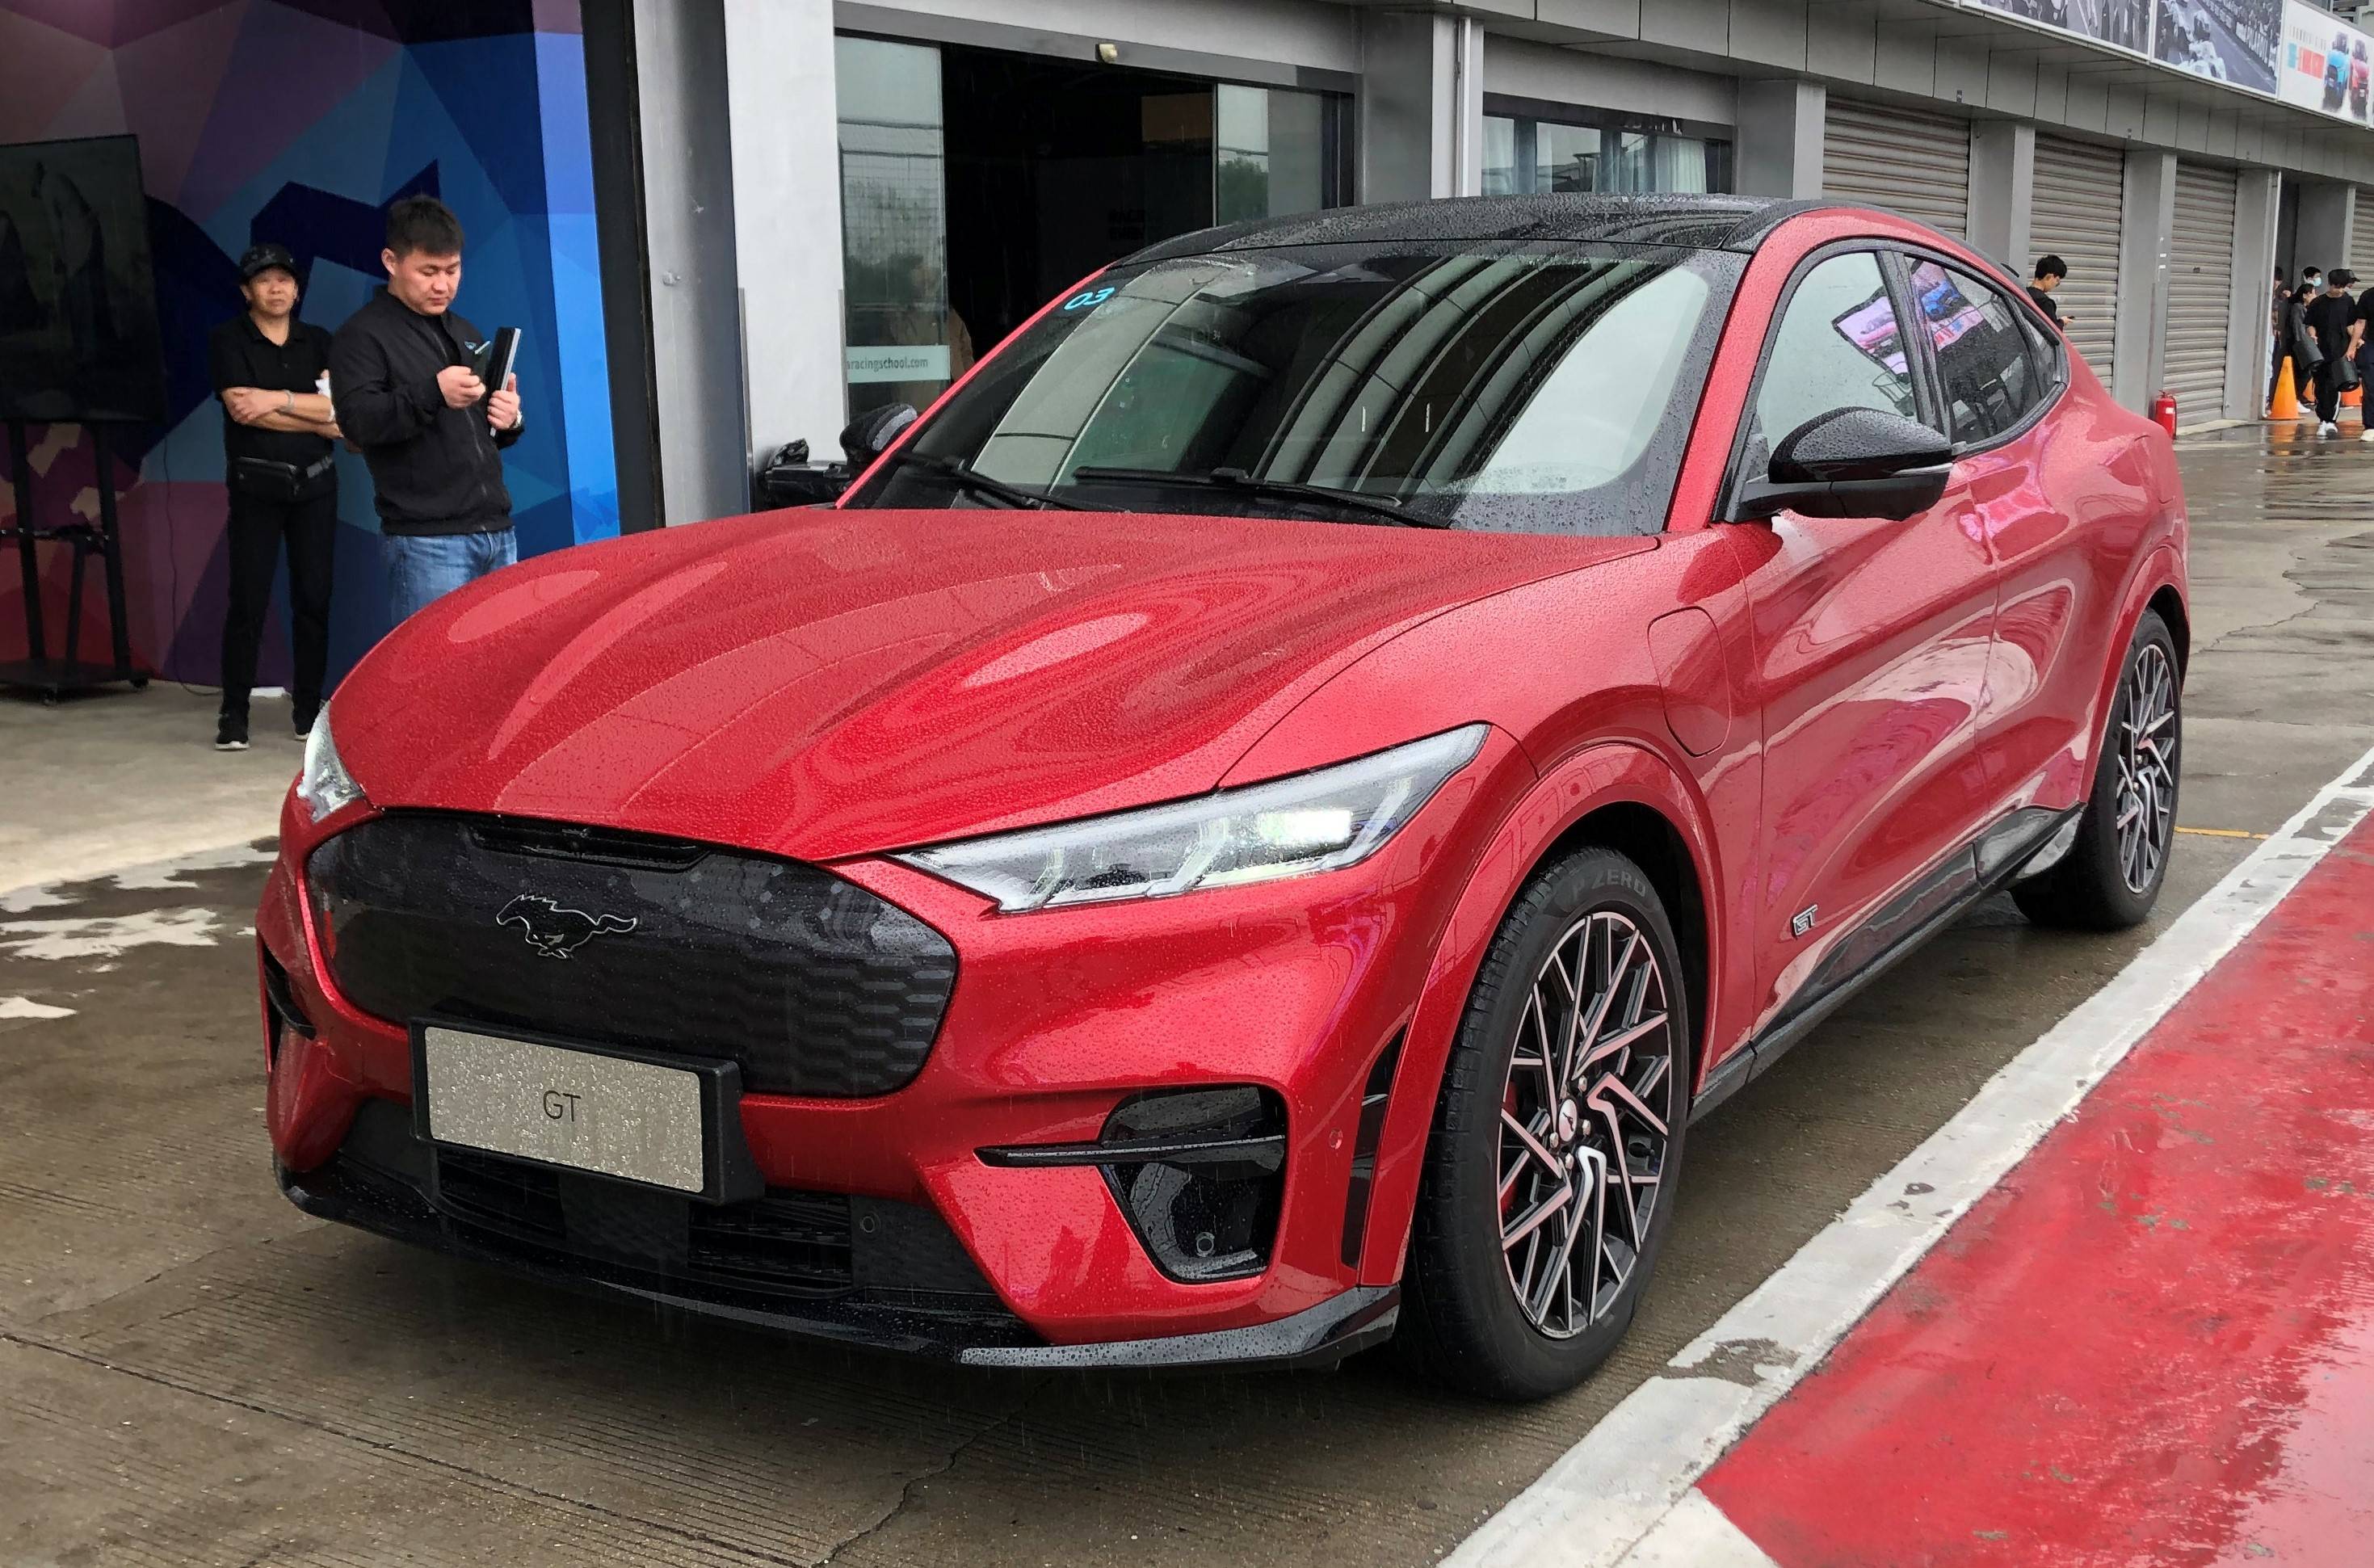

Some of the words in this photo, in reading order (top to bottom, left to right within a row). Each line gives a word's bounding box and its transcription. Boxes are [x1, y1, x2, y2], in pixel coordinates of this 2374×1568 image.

[1064, 287, 1116, 310] 03
[1591, 868, 1646, 898] ZERO
[1792, 904, 1818, 935] GT
[543, 1091, 582, 1122] GT
